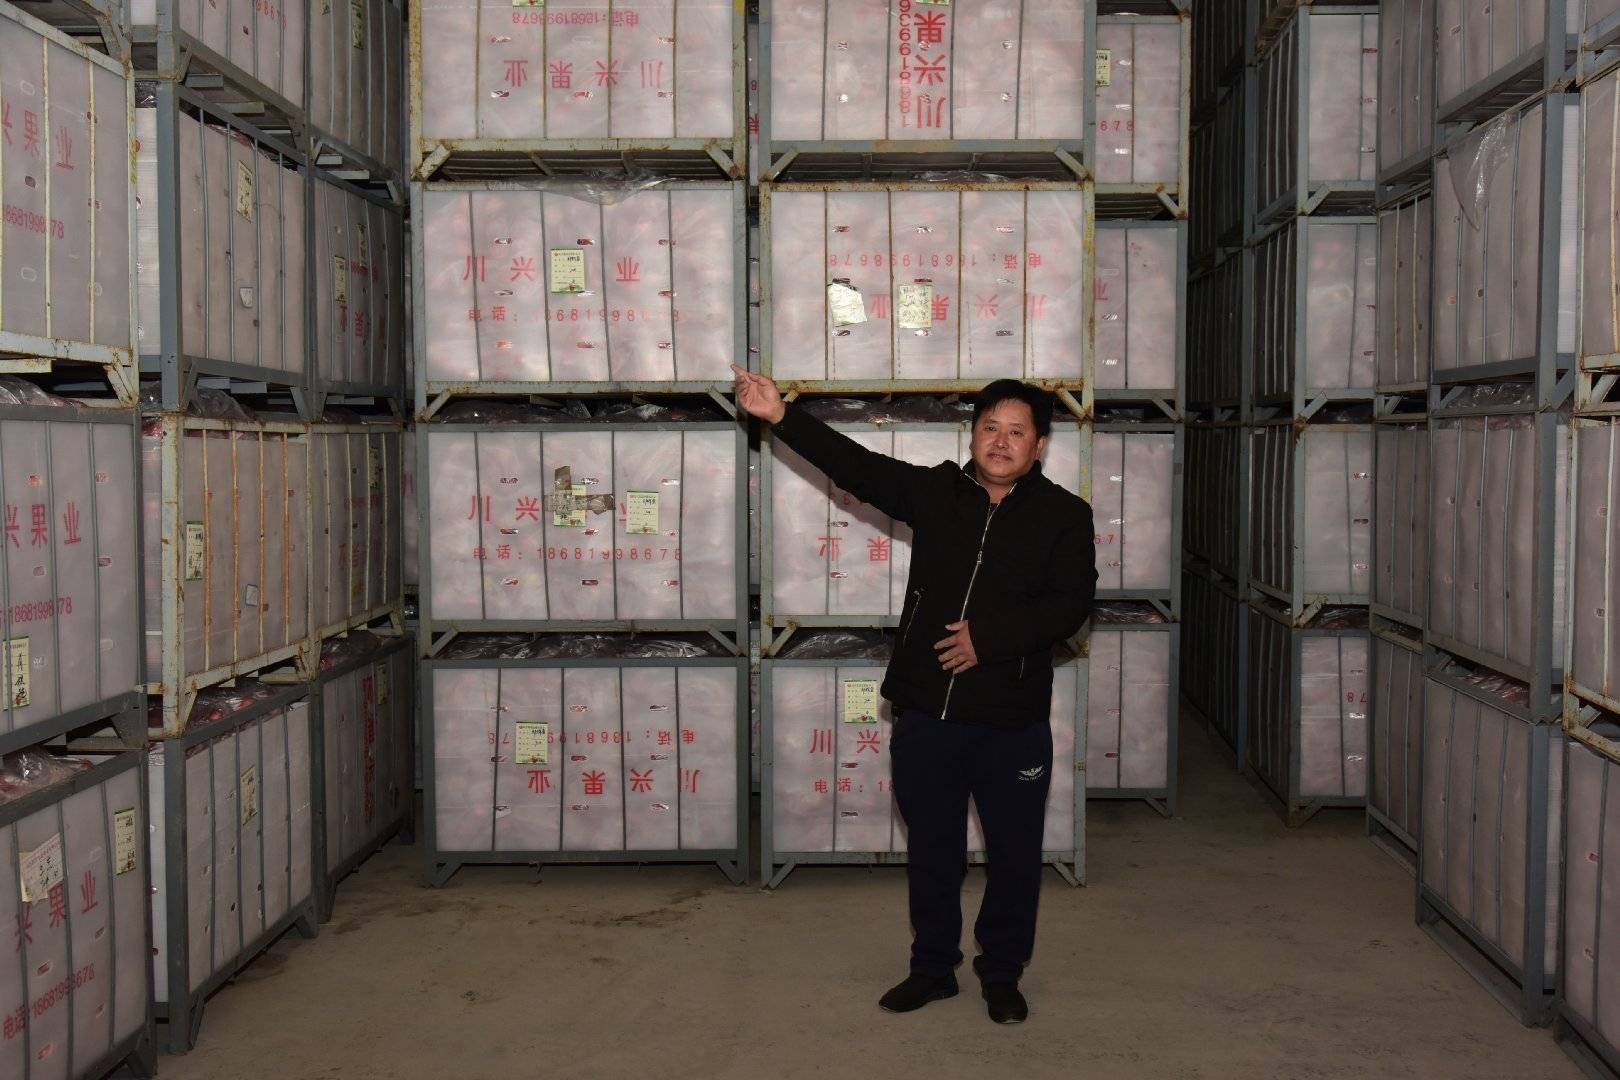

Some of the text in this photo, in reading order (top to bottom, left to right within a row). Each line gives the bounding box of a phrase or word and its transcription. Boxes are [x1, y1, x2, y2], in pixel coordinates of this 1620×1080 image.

[503, 59, 664, 89] 川兴果业
[913, 10, 947, 129] 川兴果
[463, 255, 641, 283] 川兴业
[809, 728, 881, 755] 川兴
[526, 768, 701, 795] 川兴果业
